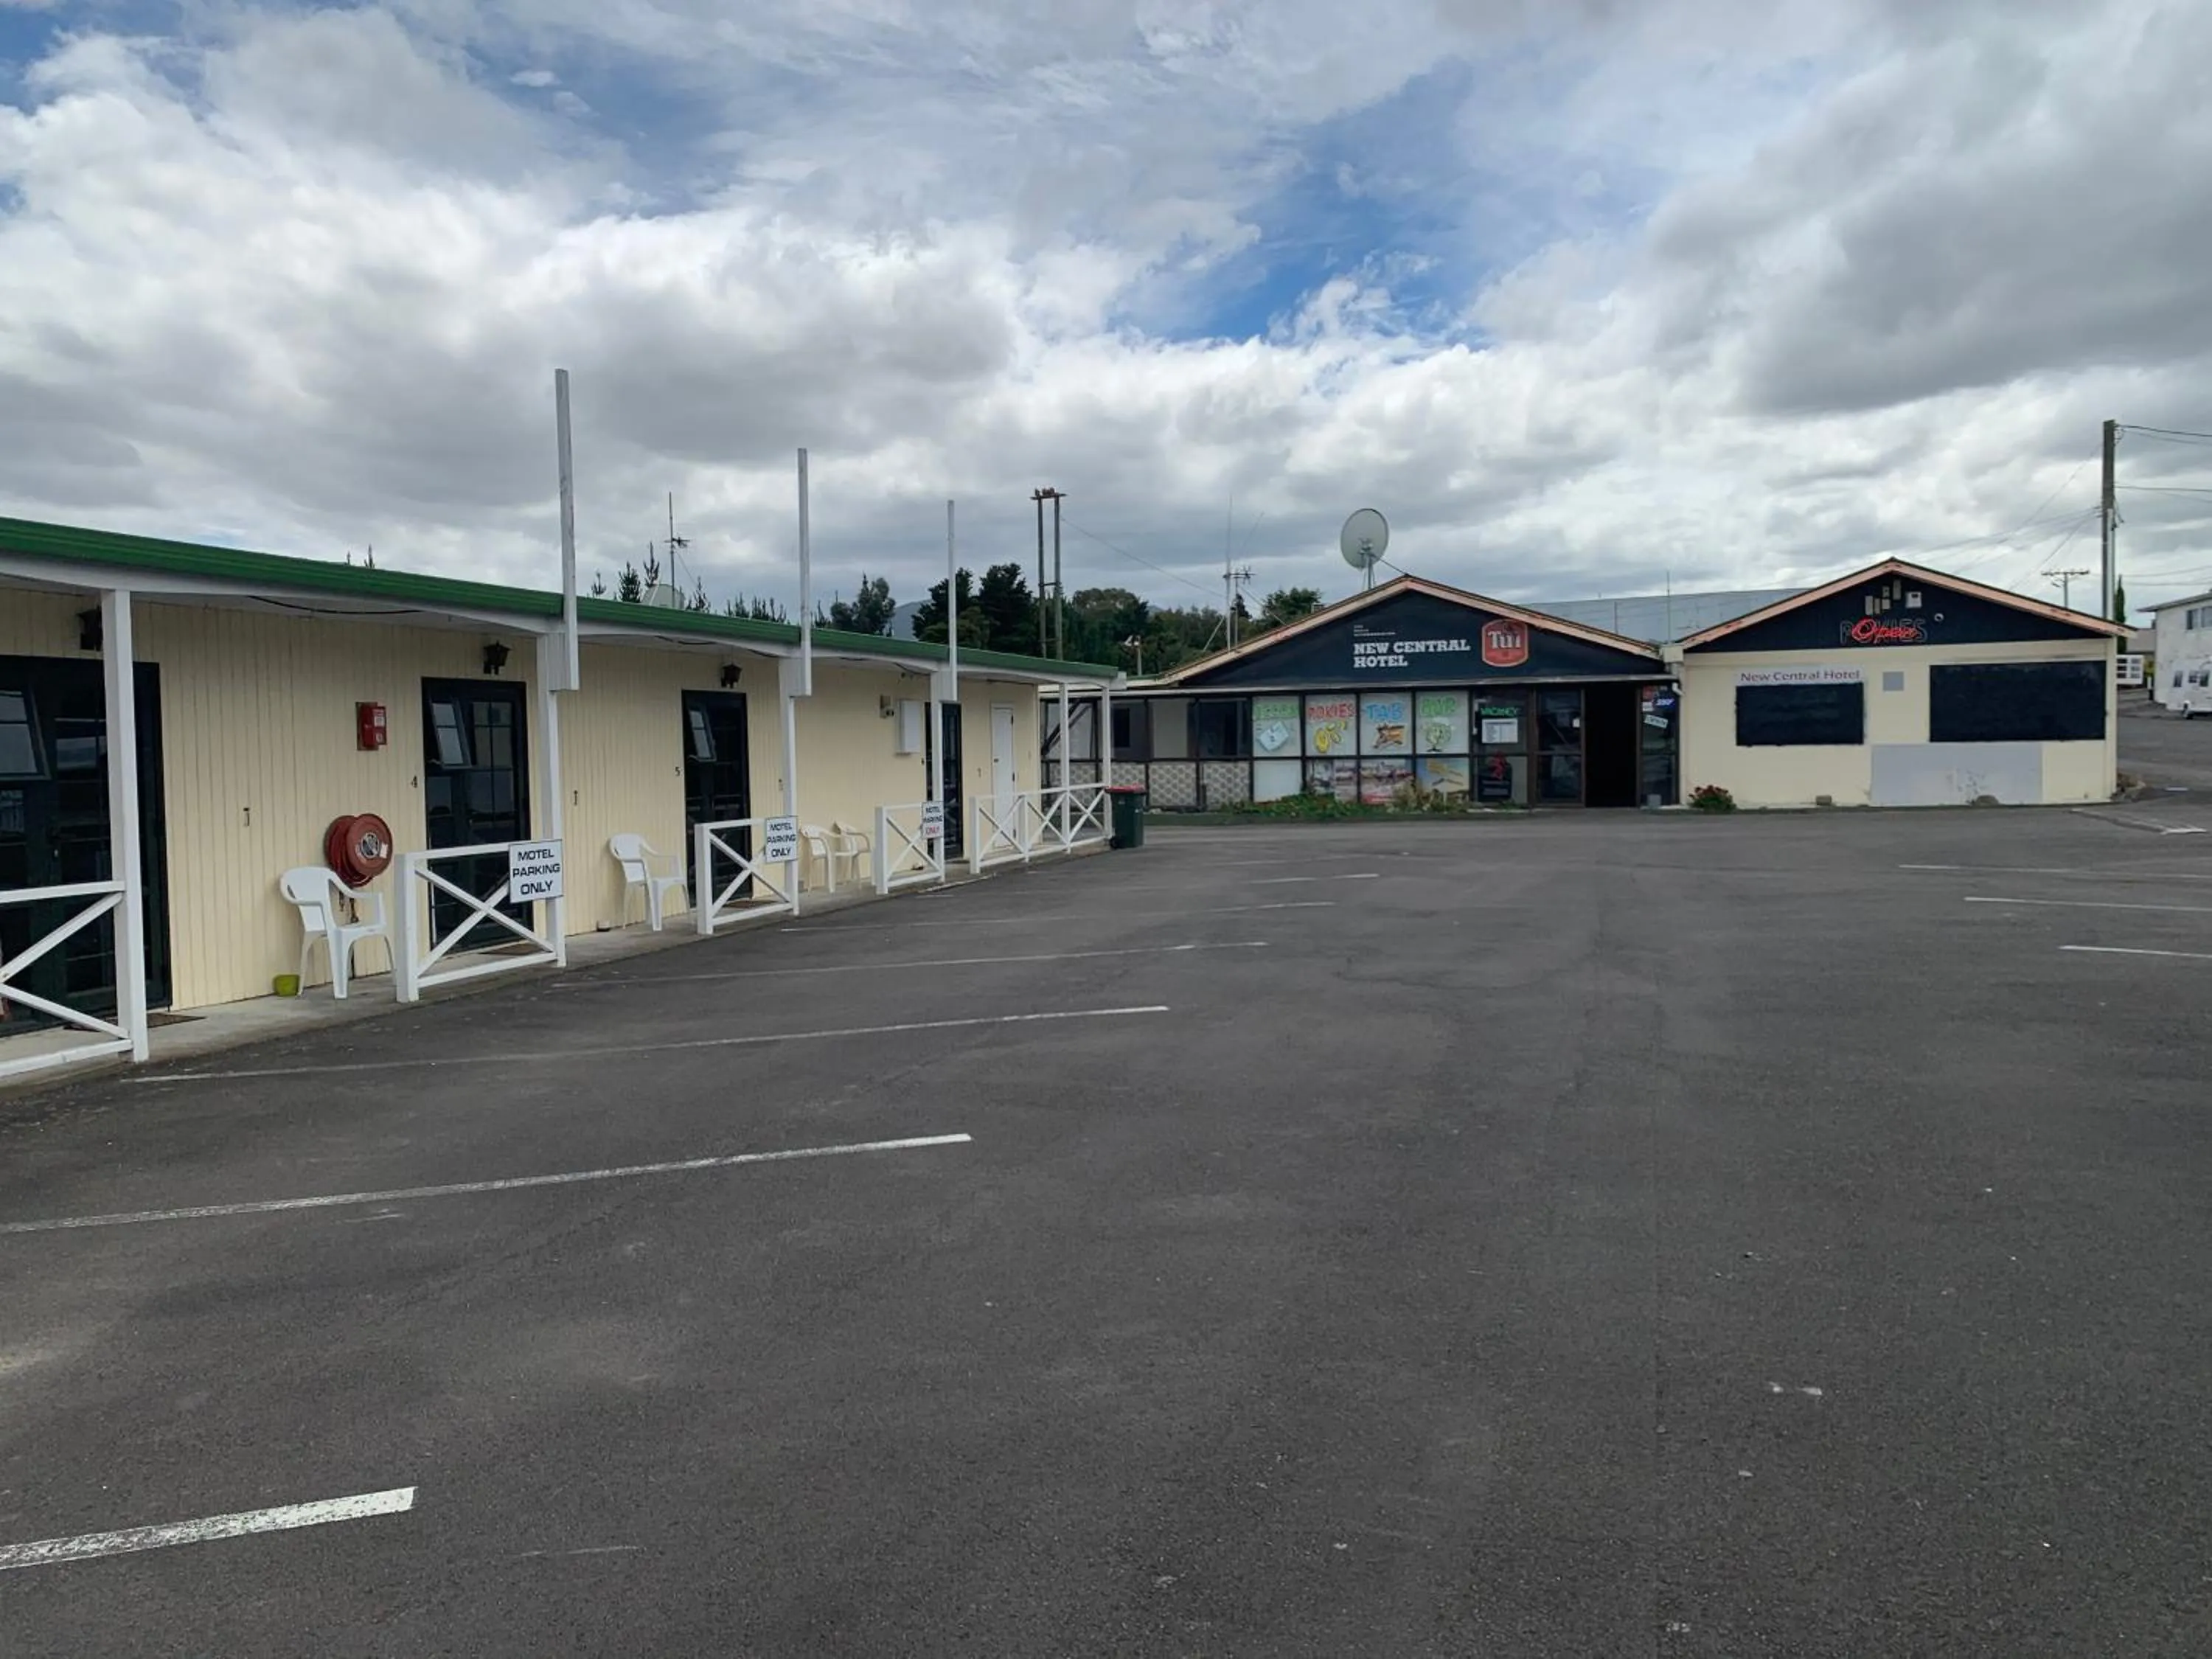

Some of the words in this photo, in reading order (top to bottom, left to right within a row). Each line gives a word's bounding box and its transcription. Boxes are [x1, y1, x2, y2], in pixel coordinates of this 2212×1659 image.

[1487, 630, 1522, 649] Tui
[1354, 641, 1389, 655] NEW
[1393, 639, 1471, 653] CENTRAL
[1354, 655, 1408, 668] HOTEL
[1740, 672, 1770, 682] New
[1773, 671, 1820, 681] Central
[1823, 669, 1860, 680] Hotel
[1365, 700, 1405, 721] TAB
[675, 766, 681, 776] 5
[411, 775, 418, 788] 4
[770, 822, 792, 831] MOTEL
[767, 834, 796, 844] PARKING
[518, 849, 554, 861] MOTEL
[771, 847, 791, 857] ONLY
[512, 863, 560, 878] PARKING
[520, 880, 553, 895] ONLY
